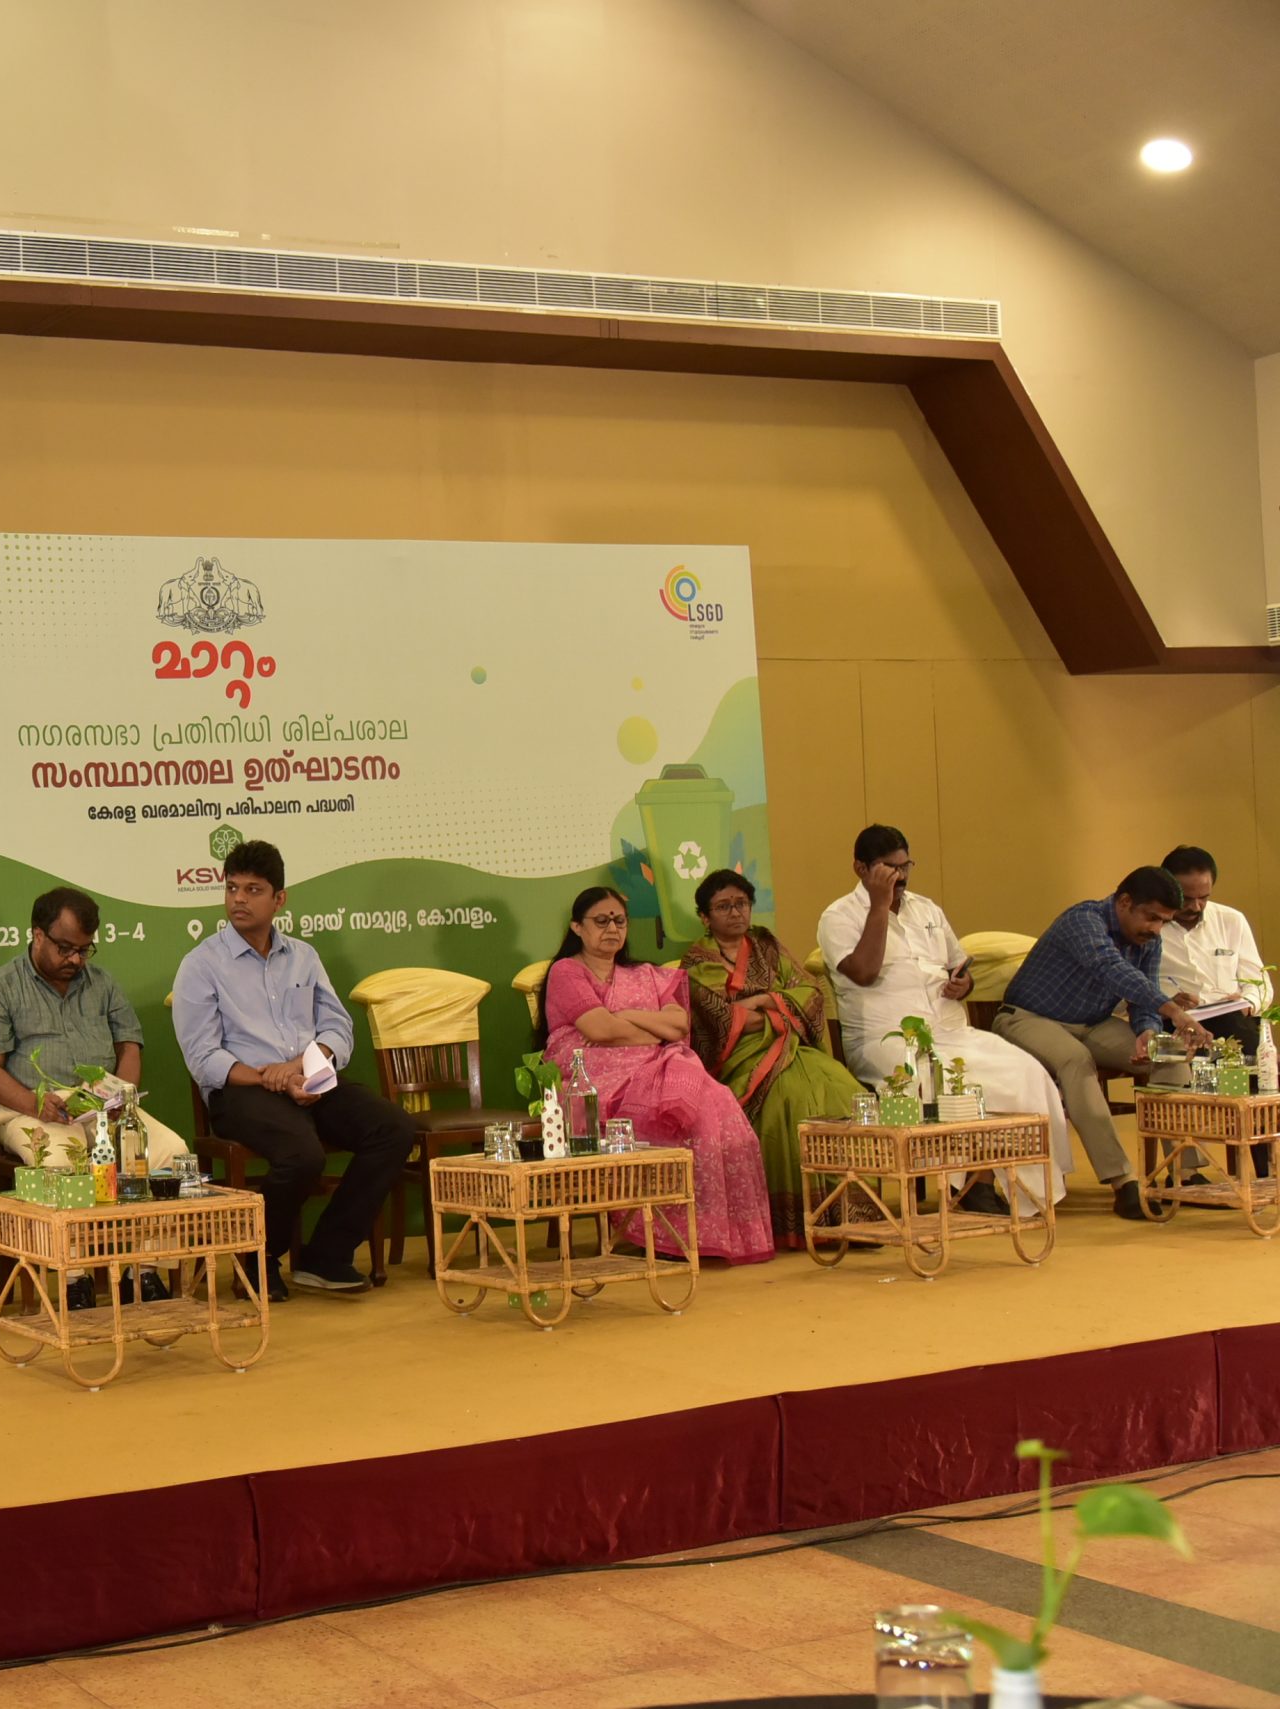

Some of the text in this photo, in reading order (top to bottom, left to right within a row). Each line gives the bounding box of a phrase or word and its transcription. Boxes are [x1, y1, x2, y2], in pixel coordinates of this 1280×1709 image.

[688, 603, 723, 621] LSGD
[152, 640, 276, 709] മാറ്റം
[18, 724, 140, 746] നഗരസഭാ
[153, 715, 271, 751] പ്രതിനിധി
[32, 758, 233, 788] സംസ്ഥാനതല
[88, 794, 354, 823] കേരള ഖരമാലിന്യ പരിപാലന പദ്ധതി
[177, 868, 226, 885] KSW
[300, 907, 345, 937] ഉദയ്
